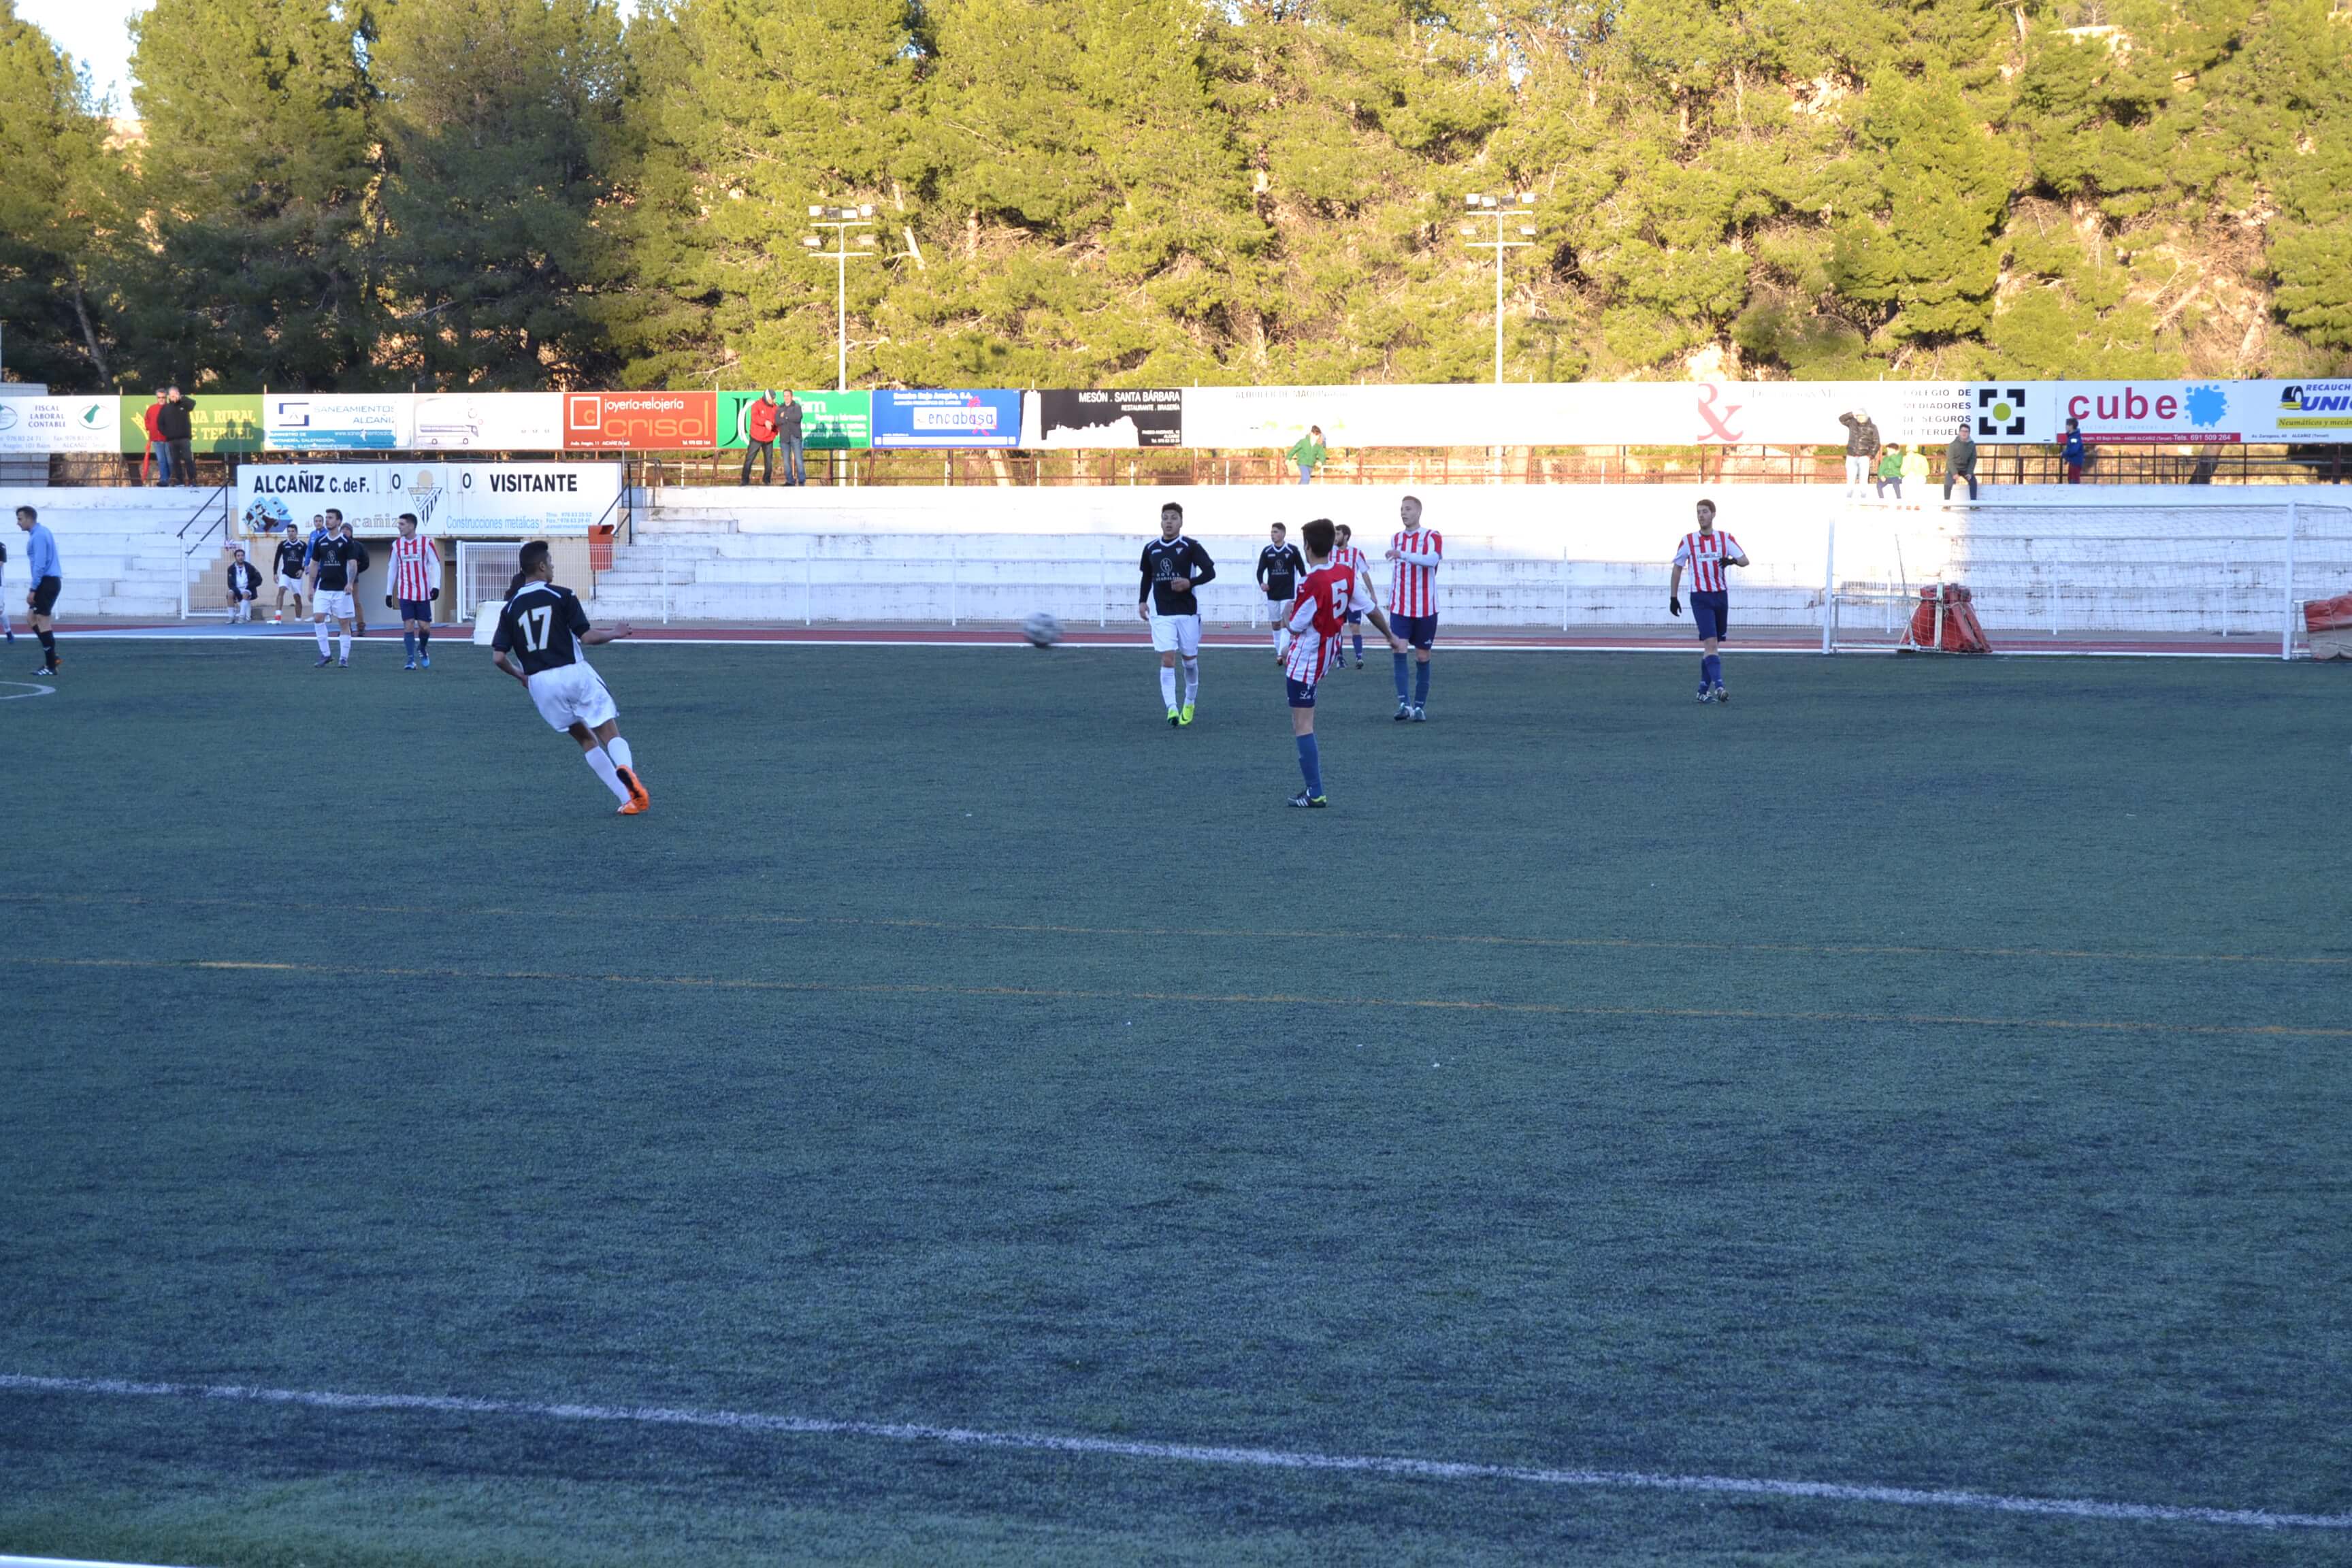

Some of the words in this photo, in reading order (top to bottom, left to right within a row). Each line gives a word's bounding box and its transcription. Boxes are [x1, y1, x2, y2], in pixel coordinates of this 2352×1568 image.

[1079, 391, 1108, 403] MESÓN
[1115, 392, 1141, 402] SANTA
[1143, 391, 1180, 402] BÁRBARA
[2068, 387, 2178, 420] cube
[2302, 396, 2352, 411] UNI
[604, 397, 684, 413] joyería-relojería
[189, 410, 209, 423] AJA
[213, 410, 256, 423] RURAL
[604, 400, 708, 436] crisol
[928, 412, 993, 425] encabasa
[1922, 414, 1972, 423] SEGUROS
[201, 426, 253, 440] TERUEL
[253, 470, 325, 493] ALCAÑIZ
[329, 477, 341, 493] C.
[344, 479, 357, 492] de
[359, 478, 370, 492] F.
[489, 474, 578, 492] VISITANTE
[446, 516, 502, 529] Construcciones
[505, 516, 539, 529] metálicas
[1331, 578, 1348, 619] 5
[517, 605, 553, 652] 17
